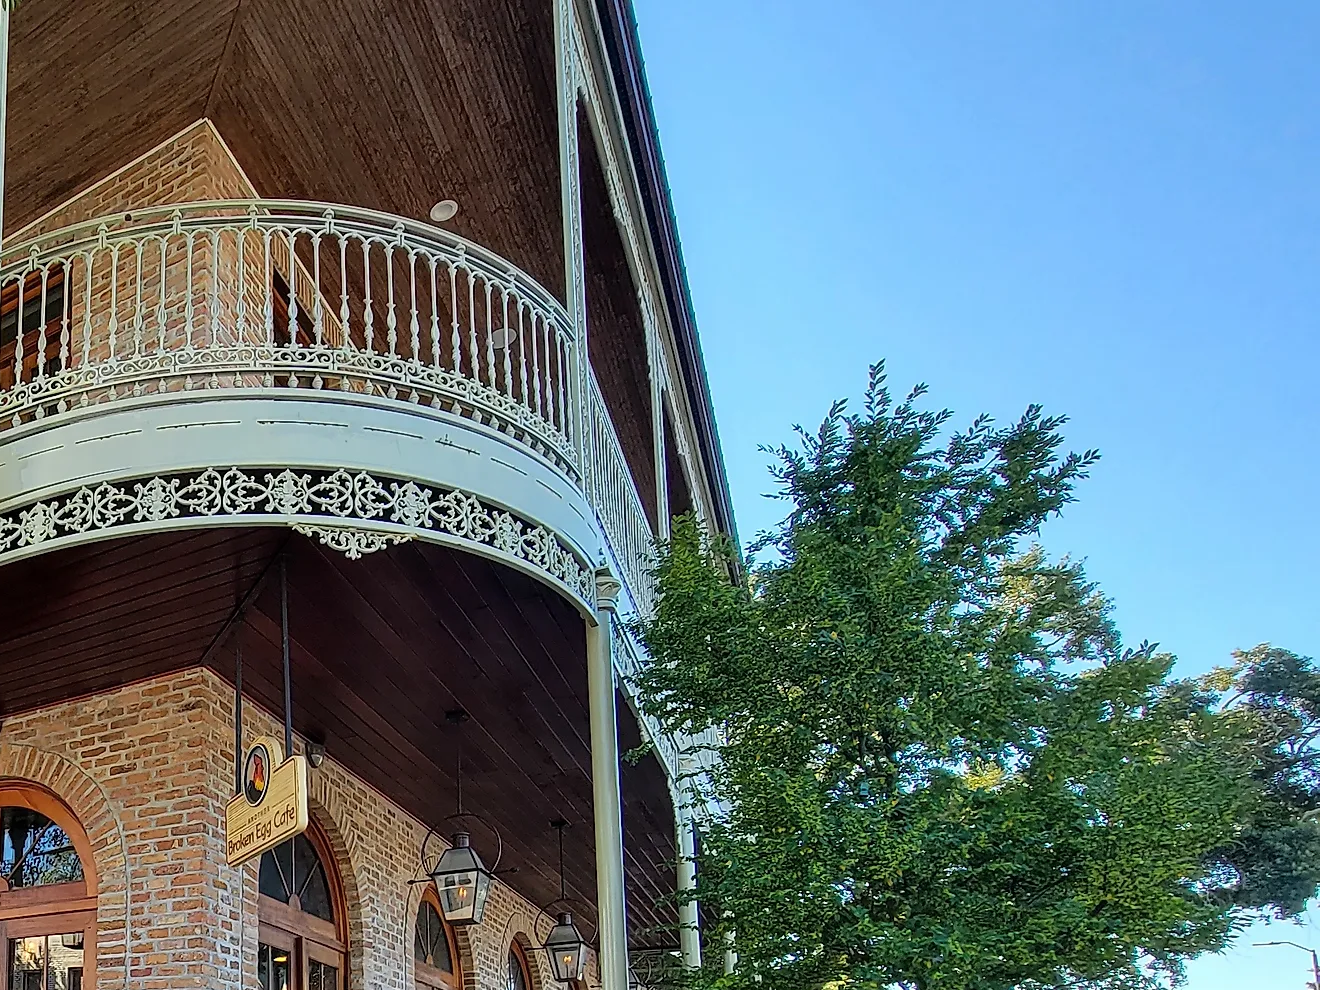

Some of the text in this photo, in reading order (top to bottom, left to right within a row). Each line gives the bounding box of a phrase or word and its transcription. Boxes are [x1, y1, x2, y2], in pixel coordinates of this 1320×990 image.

[227, 803, 295, 856] Broken Egg Cafe
